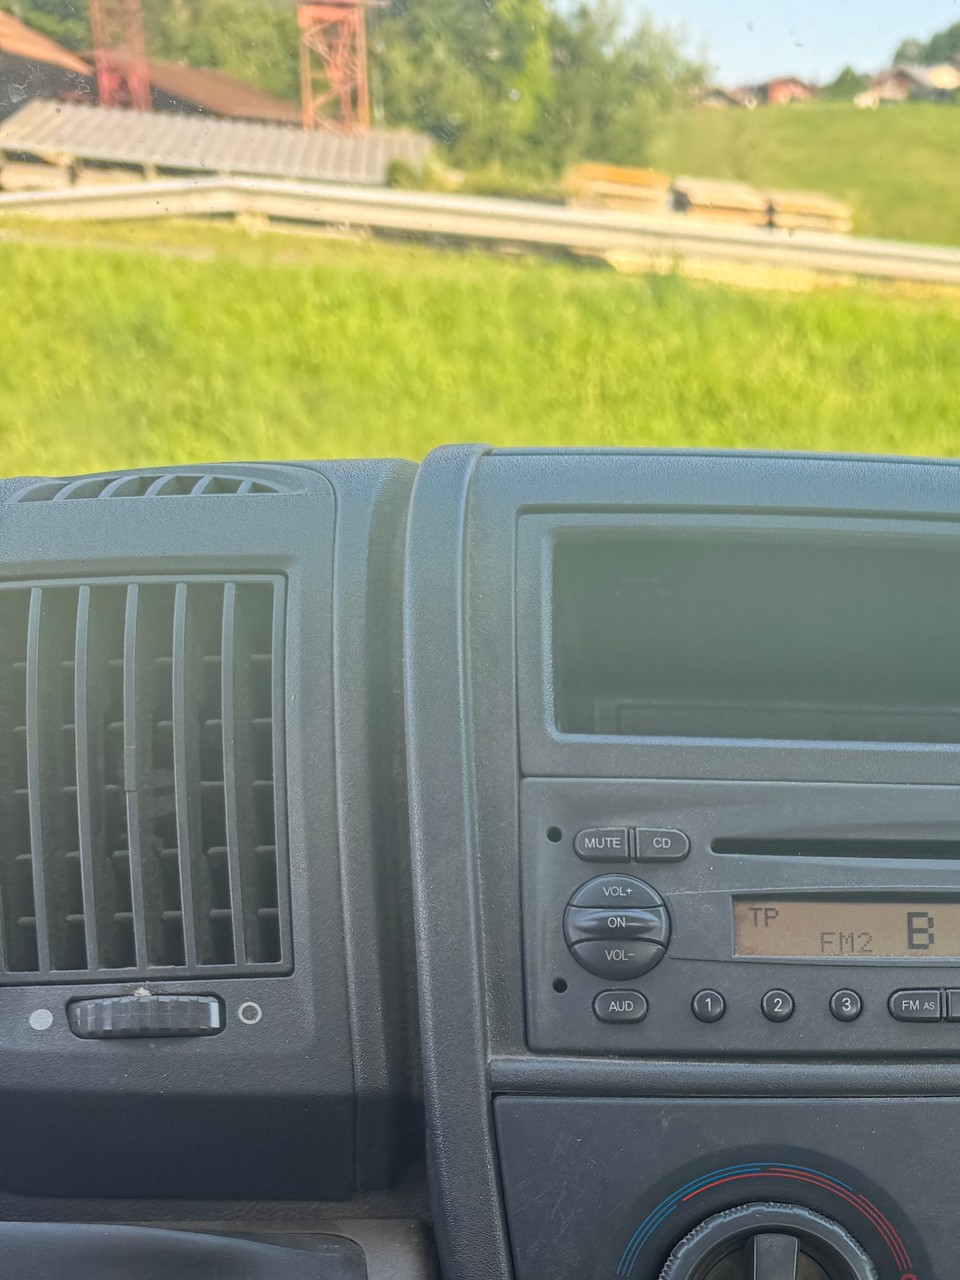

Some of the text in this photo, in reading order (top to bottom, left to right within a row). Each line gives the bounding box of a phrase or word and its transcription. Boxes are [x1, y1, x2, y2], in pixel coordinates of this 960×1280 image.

[584, 837, 621, 849] MUTE
[652, 837, 671, 849] CD
[607, 916, 626, 928] ON
[748, 907, 779, 928] TP
[820, 931, 873, 953] FM2
[609, 1000, 634, 1013] AUD
[705, 997, 712, 1012] 1
[774, 998, 783, 1013] 2
[842, 997, 852, 1011] 3
[902, 999, 934, 1011] FM AS
